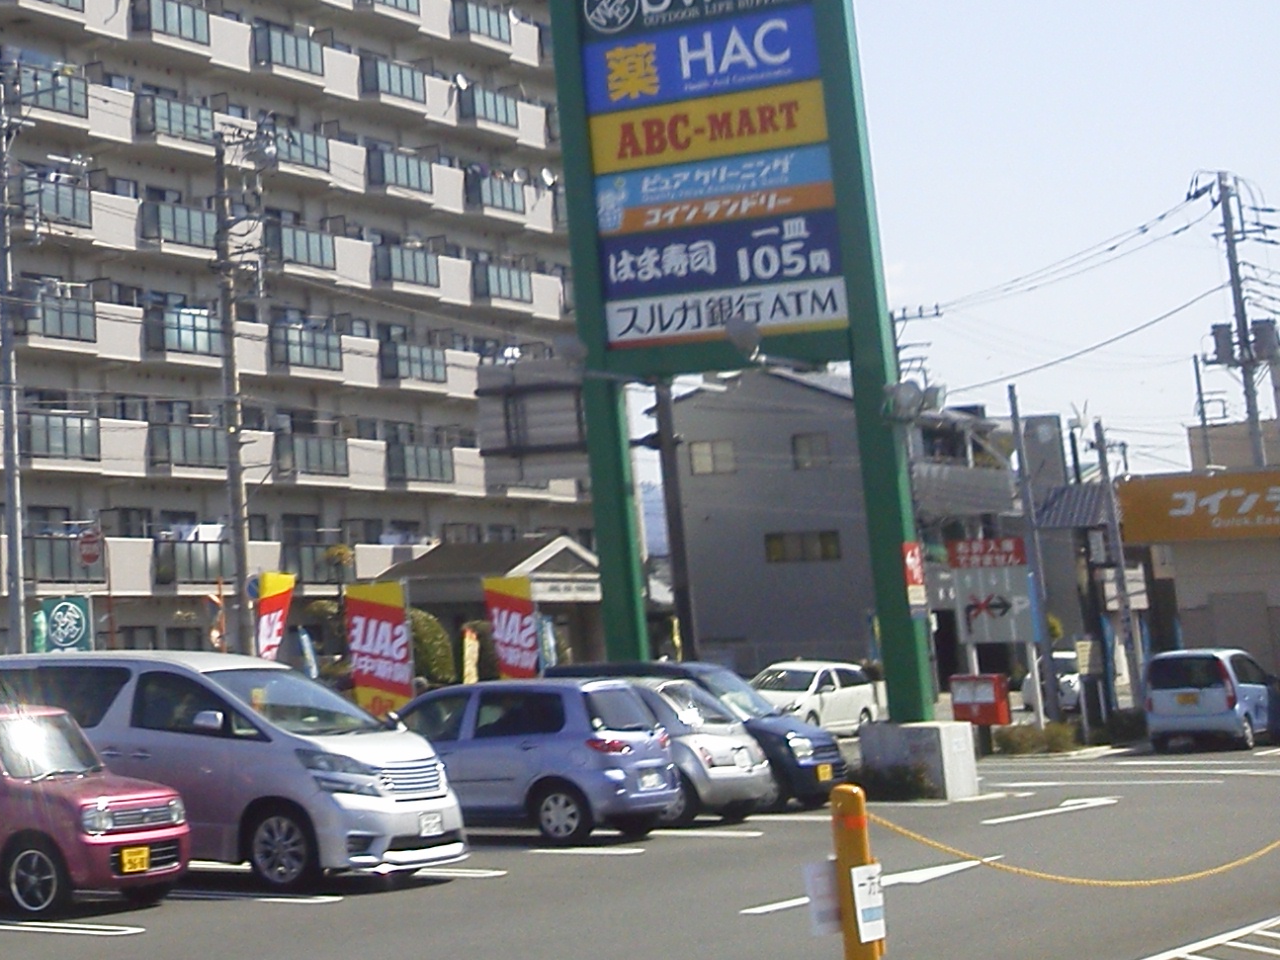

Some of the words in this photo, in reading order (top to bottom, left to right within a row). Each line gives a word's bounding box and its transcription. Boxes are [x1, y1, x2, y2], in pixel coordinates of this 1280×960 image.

[643, 5, 700, 26] OUTDOOR
[705, 0, 733, 16] LIFE
[678, 18, 791, 79] HAC
[606, 43, 660, 102] 薬
[618, 101, 799, 159] ABC-MART
[644, 193, 793, 227] コインランドリー
[751, 217, 810, 241] 一皿
[608, 239, 718, 284] はま寿司
[736, 240, 830, 282] 105円
[770, 288, 838, 320] ATM
